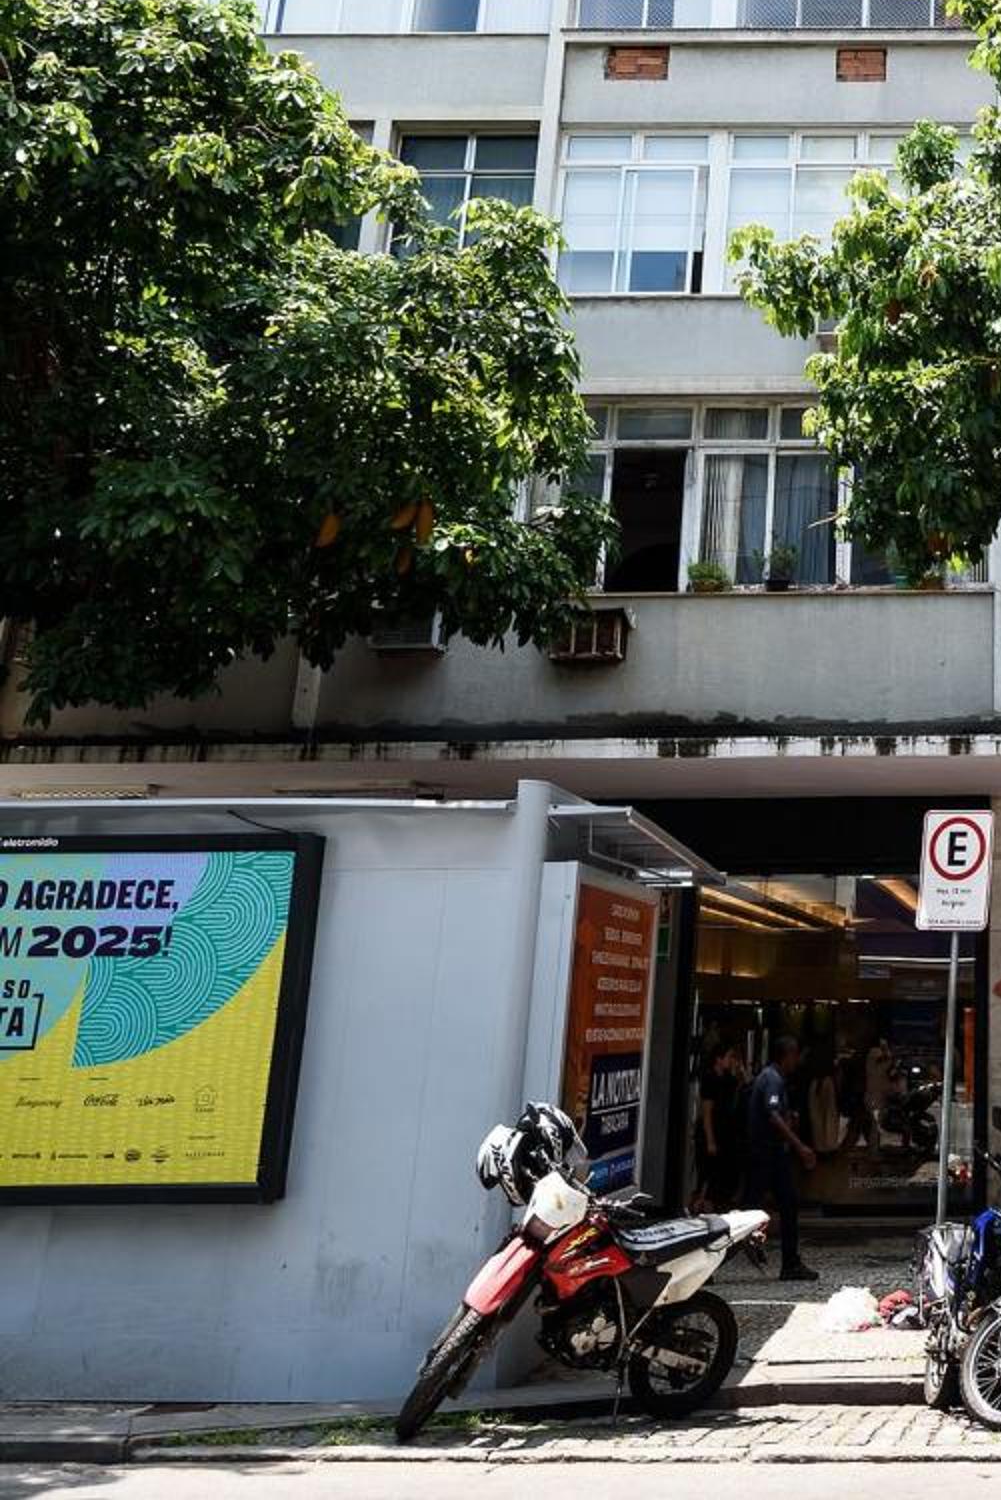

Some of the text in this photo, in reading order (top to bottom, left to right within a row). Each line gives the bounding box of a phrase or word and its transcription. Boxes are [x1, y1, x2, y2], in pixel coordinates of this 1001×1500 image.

[947, 831, 967, 866] E
[14, 879, 179, 913] AGRADECE,
[27, 925, 173, 958] 2025!
